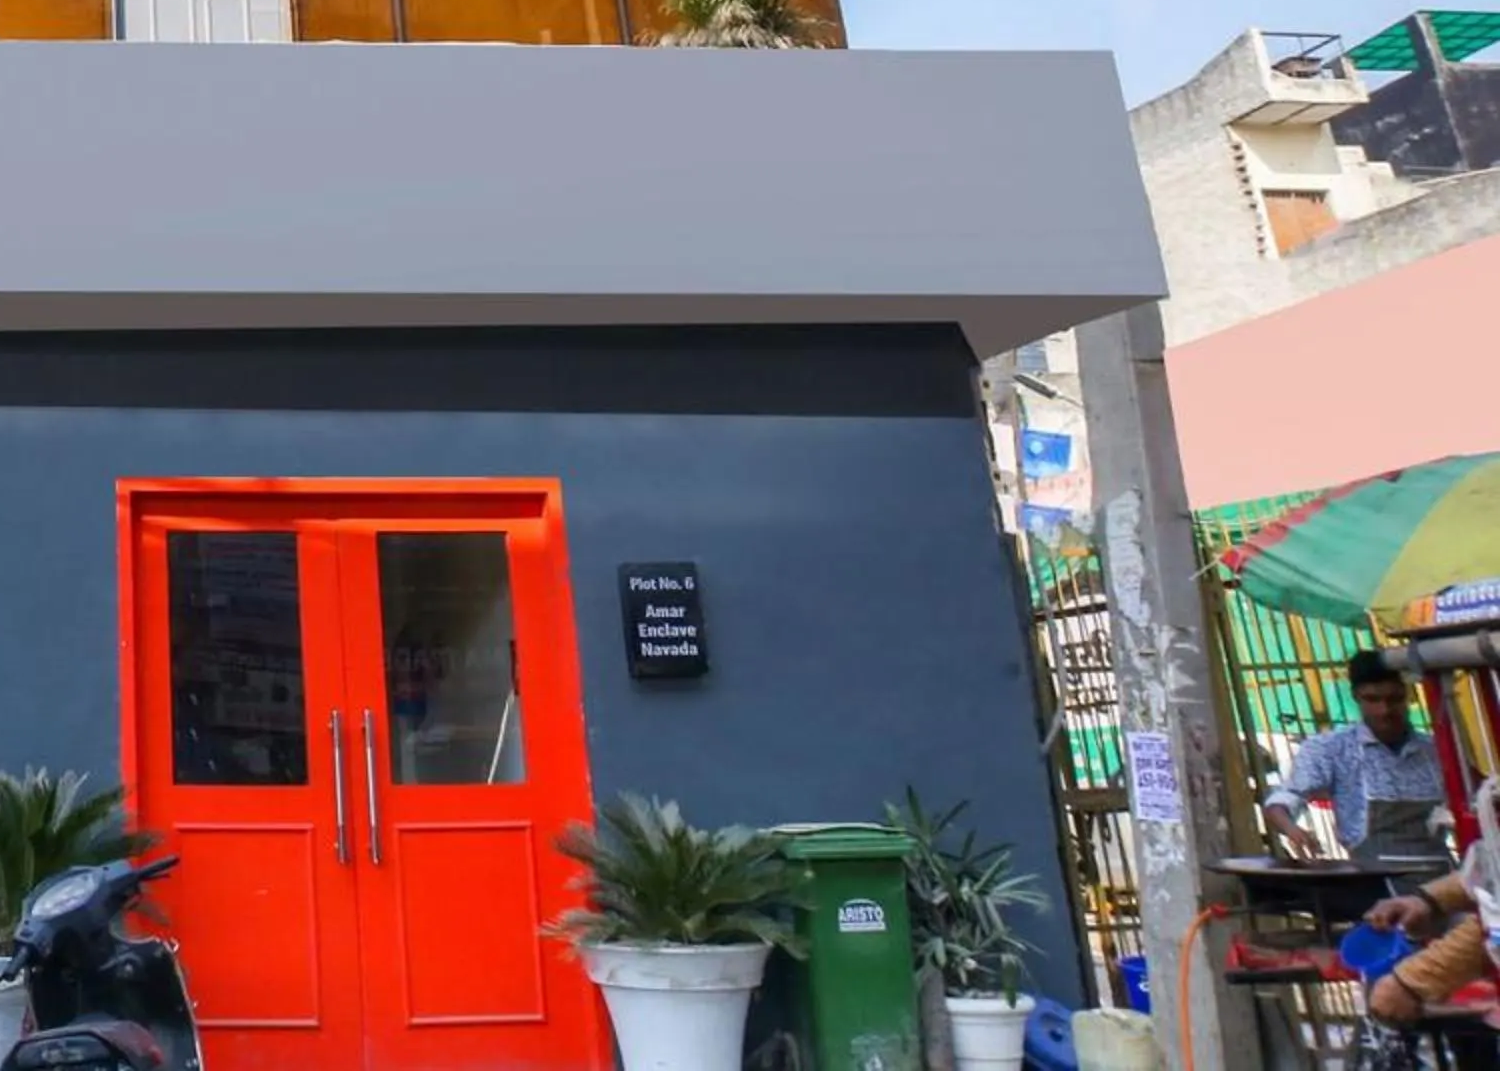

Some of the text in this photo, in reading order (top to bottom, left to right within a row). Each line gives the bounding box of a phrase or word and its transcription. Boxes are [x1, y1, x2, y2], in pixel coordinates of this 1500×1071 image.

[629, 576, 694, 590] Plot No. 6
[645, 604, 685, 618] Amar
[638, 623, 697, 638] Enclave
[641, 640, 698, 657] Navada
